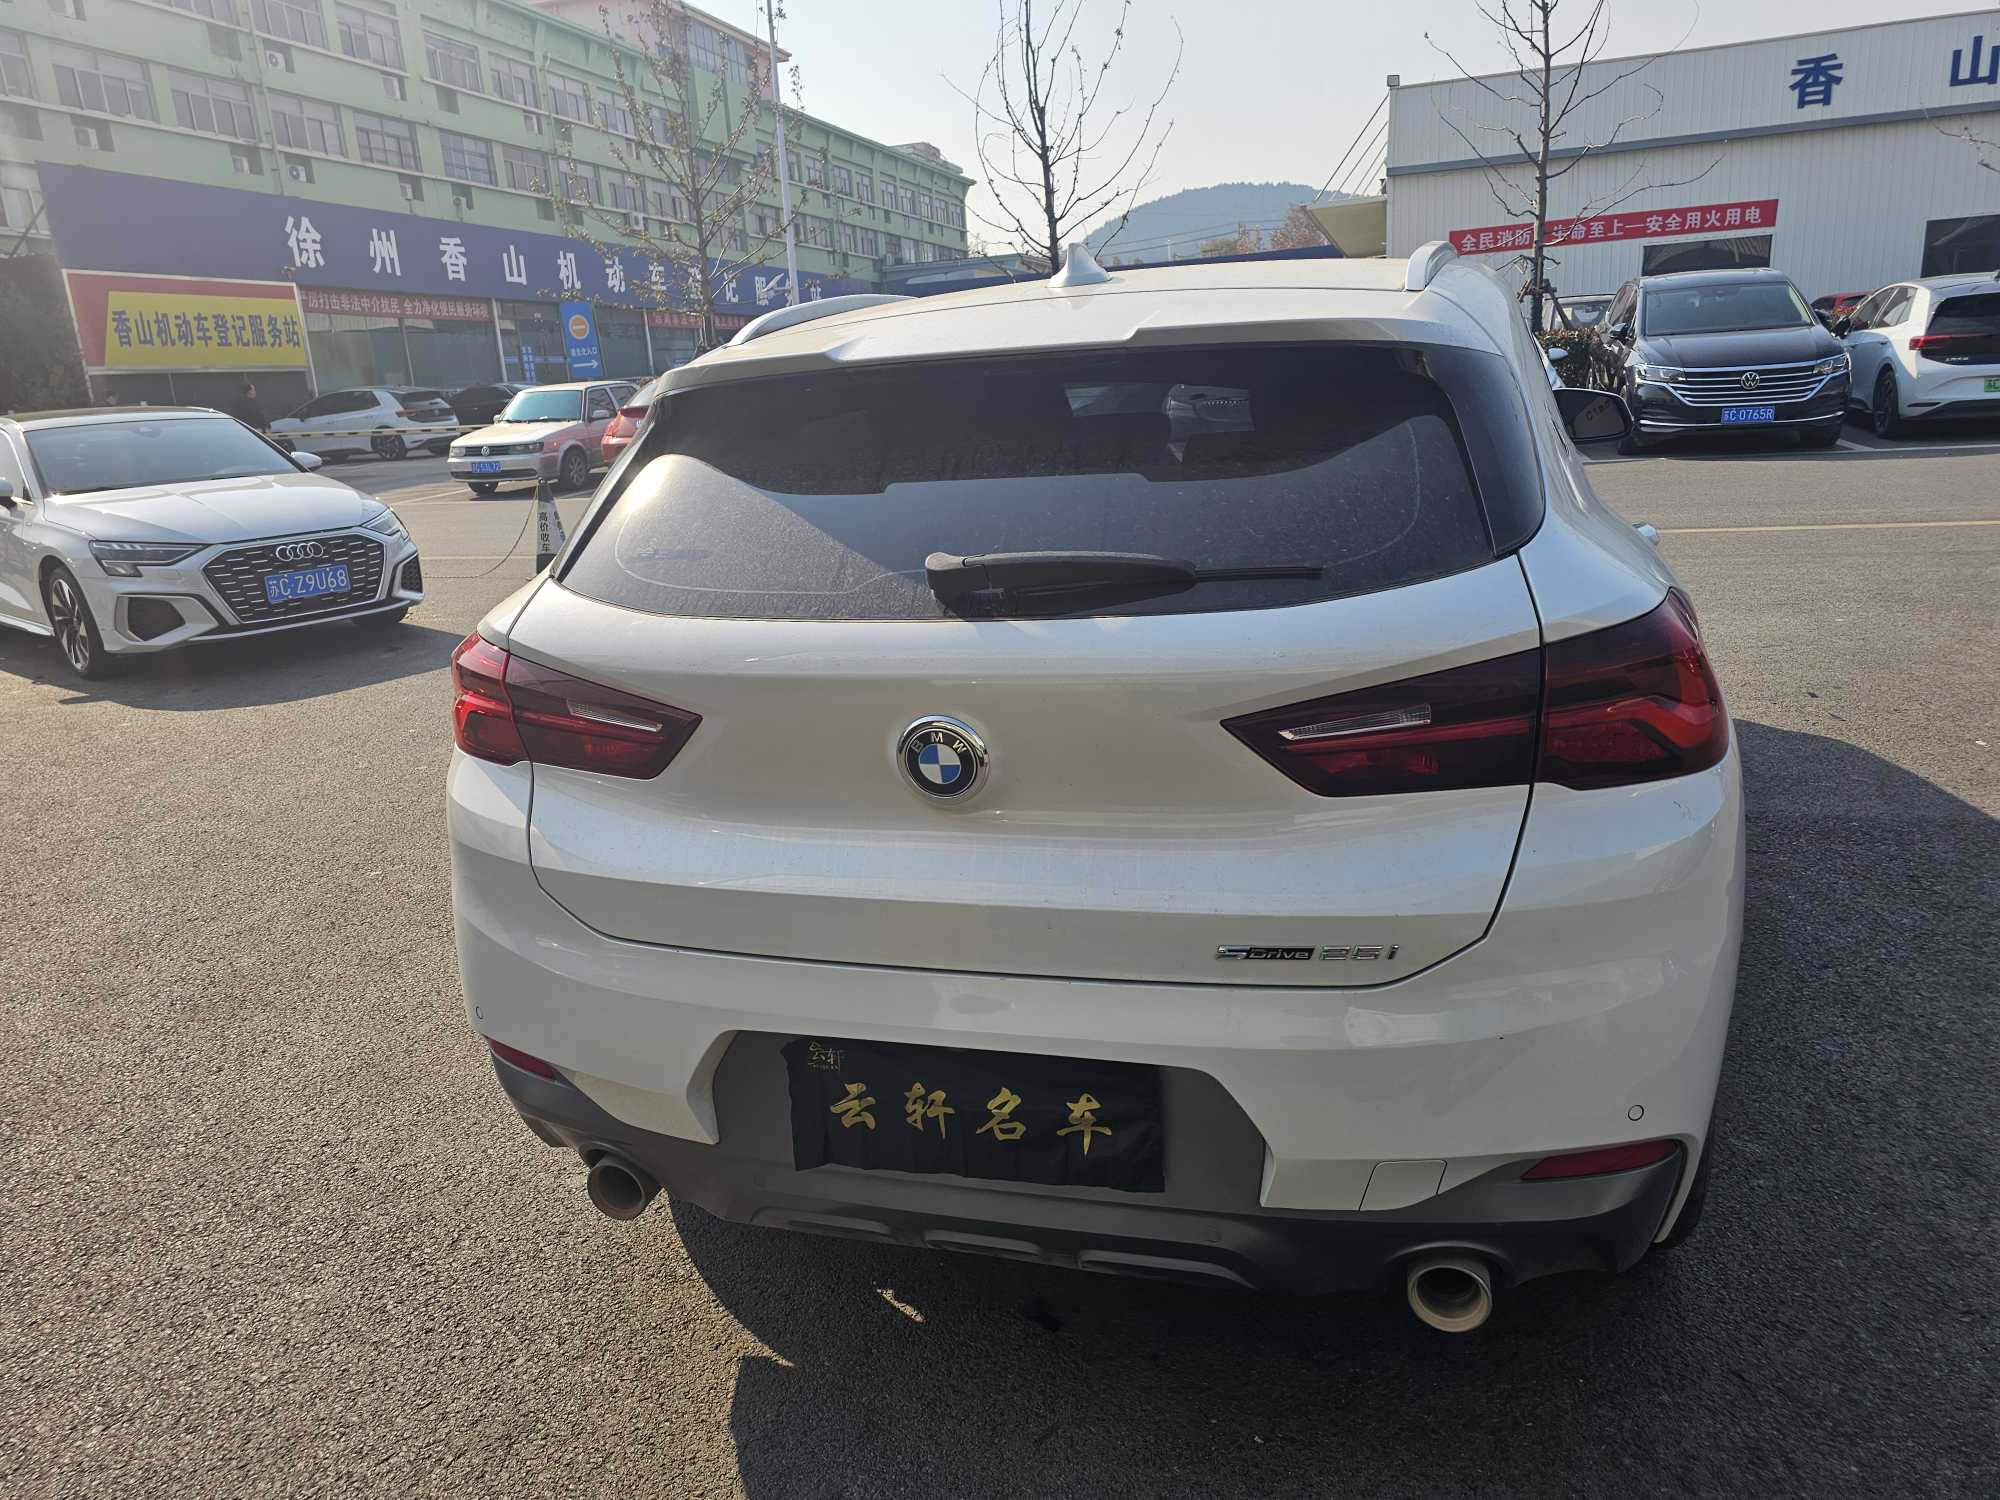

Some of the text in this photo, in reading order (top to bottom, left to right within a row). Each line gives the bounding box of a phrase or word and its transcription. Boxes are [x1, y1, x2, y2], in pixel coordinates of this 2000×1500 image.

[112, 310, 301, 348] 香山机动车登记服务站
[911, 731, 967, 754] BMW
[830, 1081, 1113, 1156] 云轩名车
